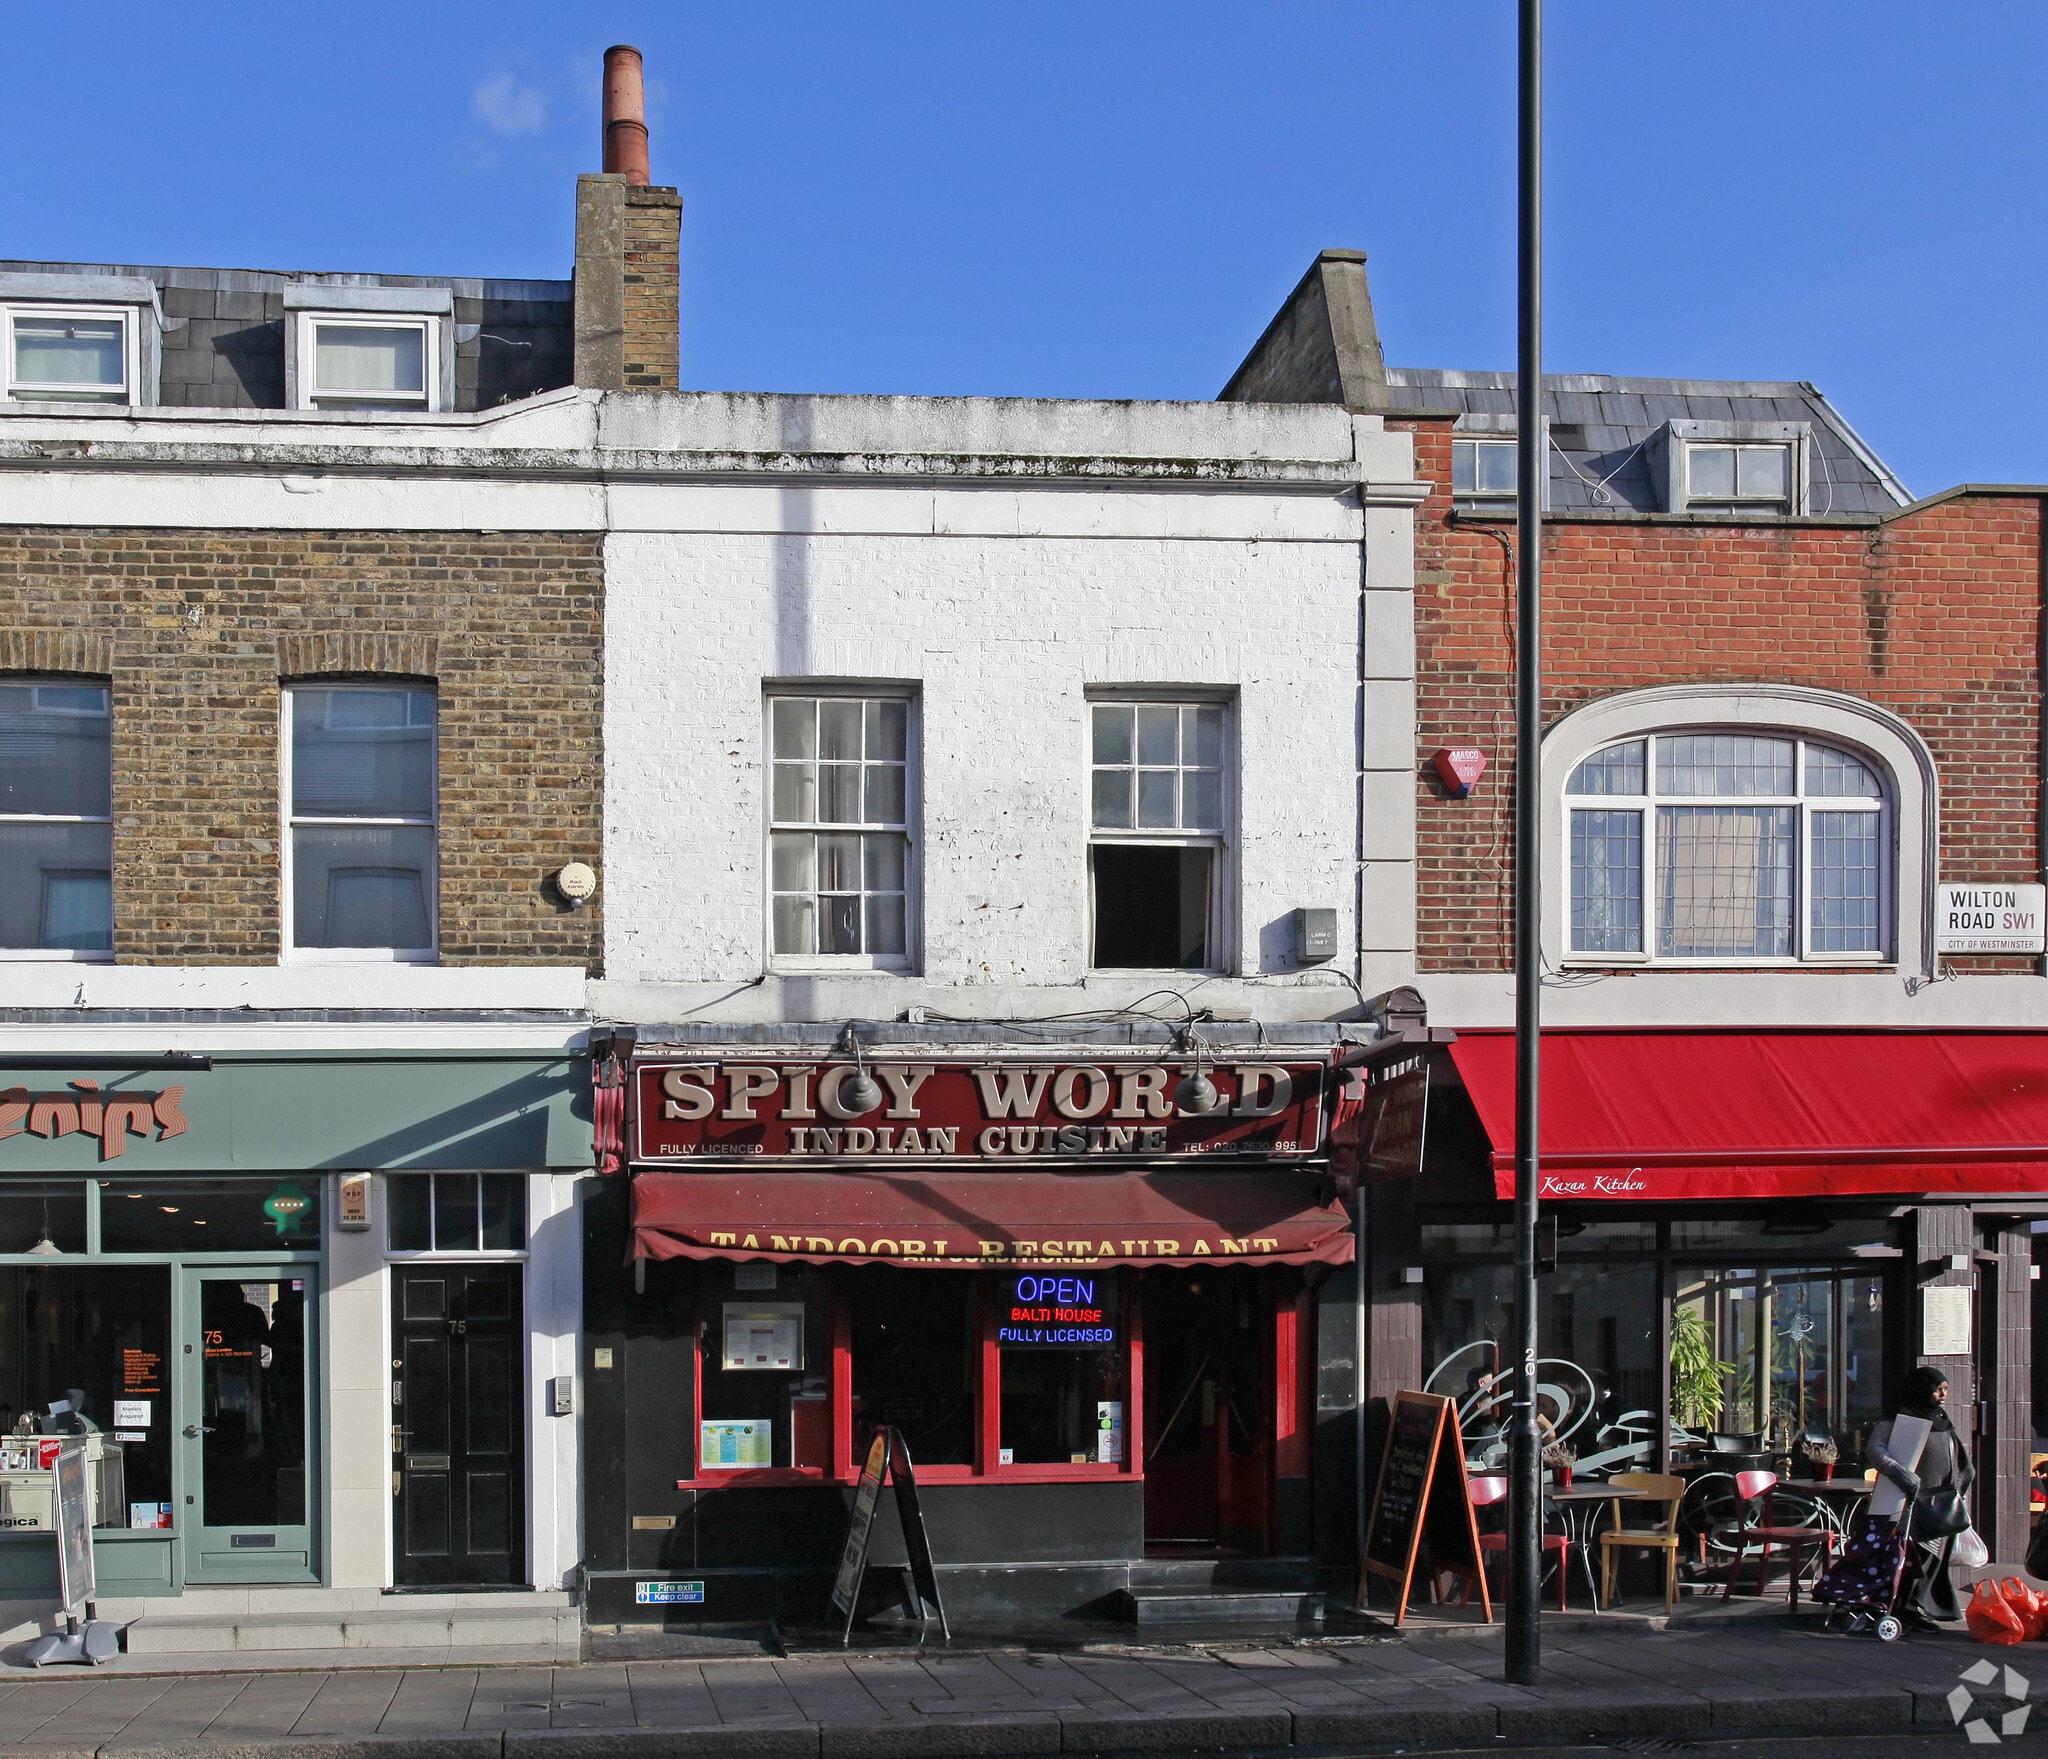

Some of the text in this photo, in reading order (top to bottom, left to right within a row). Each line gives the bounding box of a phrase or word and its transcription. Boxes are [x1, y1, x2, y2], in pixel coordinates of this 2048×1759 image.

[1451, 750, 1479, 762] MASCO
[1950, 891, 2016, 908] WILTON
[1949, 912, 2035, 930] ROAD SW1
[1948, 940, 2034, 949] CITY OF WESTMINSTER
[663, 1064, 1293, 1120] SPICY WORLD
[789, 1125, 1168, 1155] INDIAN CUISINE
[1183, 1142, 1209, 1153] TEL:
[1214, 1142, 1237, 1153] 020
[1241, 1141, 1270, 1152] 7630
[660, 1143, 764, 1154] FULLY LICENCED
[1540, 1168, 1647, 1195] Kazan Kitchen
[710, 1232, 1279, 1257] TANDOORI RESTAURANT
[1017, 1276, 1094, 1304] OPEN
[1011, 1307, 1103, 1323] BALTI HOUSE
[448, 1320, 467, 1335] 75
[1000, 1327, 1113, 1343] FULLY LICENSED
[203, 1330, 223, 1345] 75
[658, 1583, 693, 1592] Fire exit
[654, 1592, 697, 1602] Keep clear
